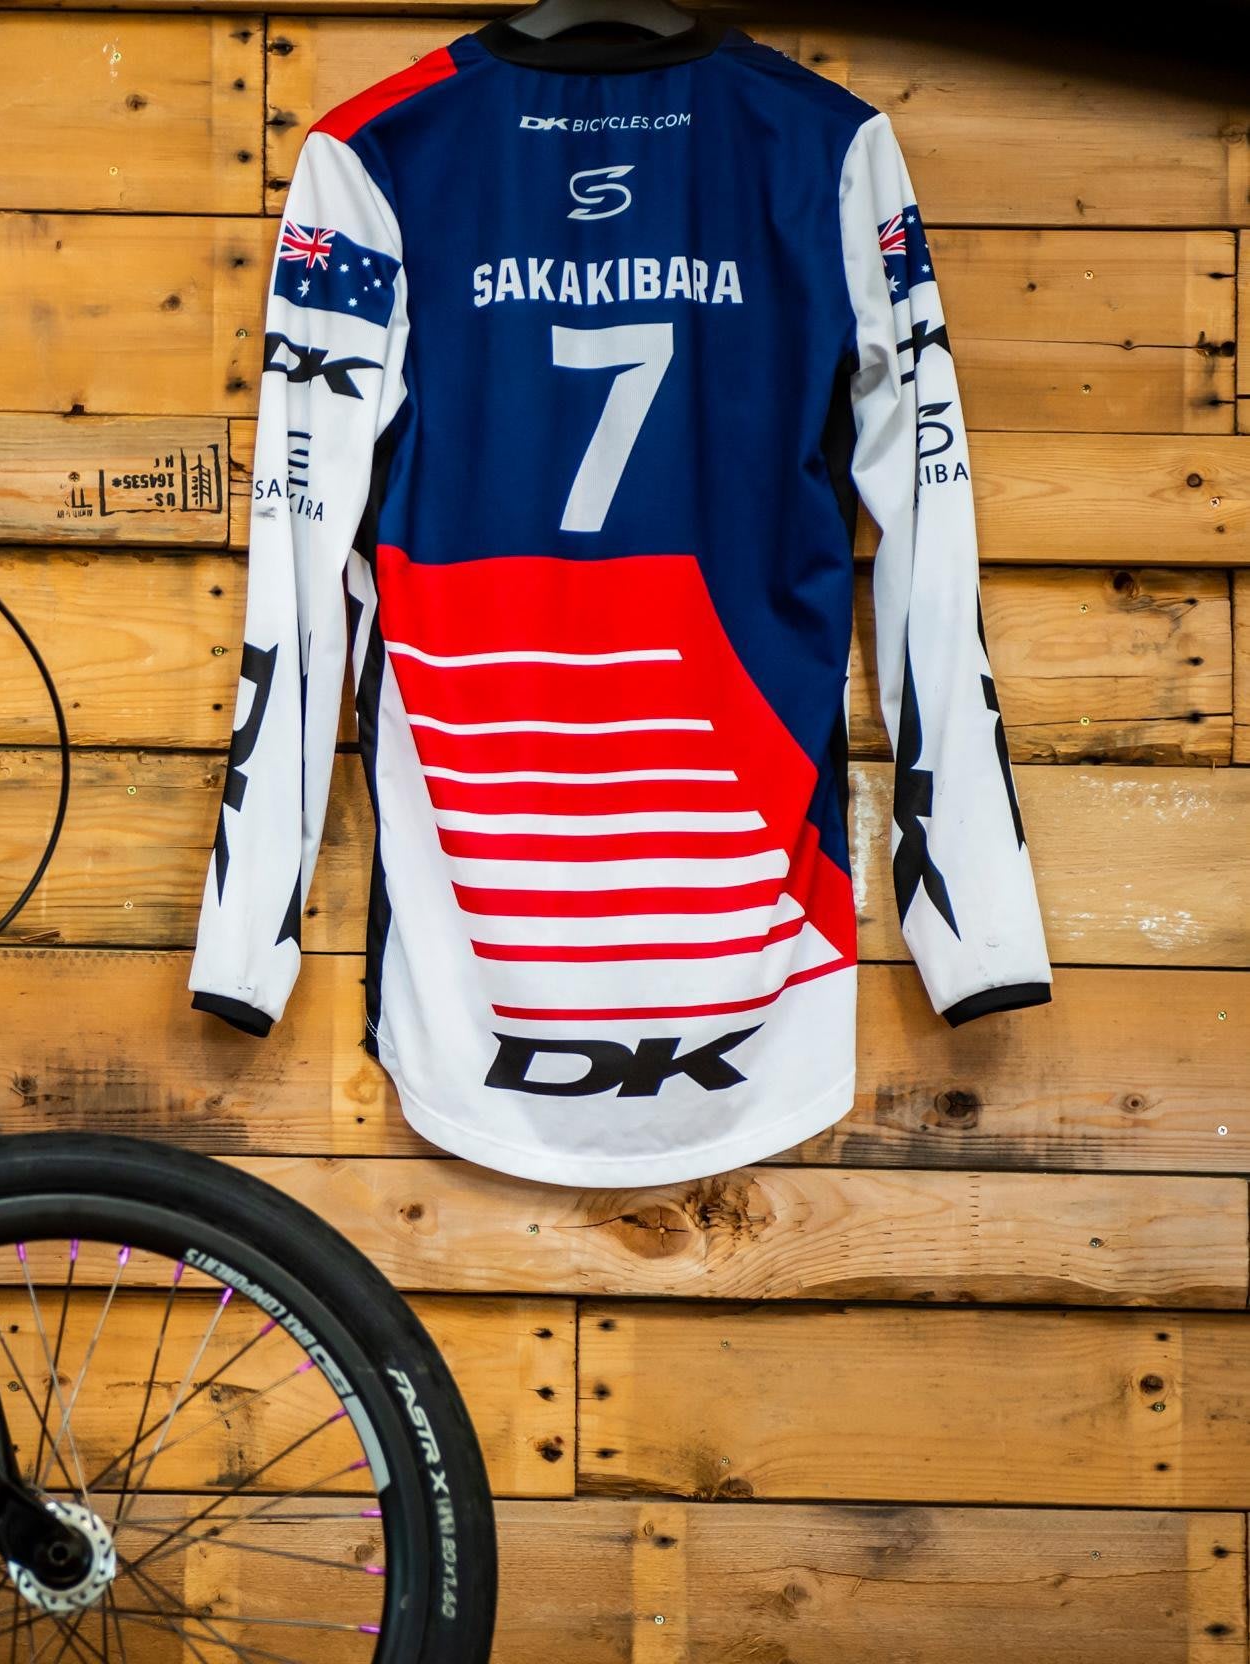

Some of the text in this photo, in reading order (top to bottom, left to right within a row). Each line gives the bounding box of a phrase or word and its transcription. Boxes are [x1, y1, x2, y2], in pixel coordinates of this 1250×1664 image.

[473, 256, 743, 308] SAKAKIBARA
[263, 332, 384, 401] DK
[551, 322, 674, 532] 7
[484, 1021, 766, 1098] DK
[387, 1368, 441, 1464] FASTR
[430, 1469, 450, 1494] X
